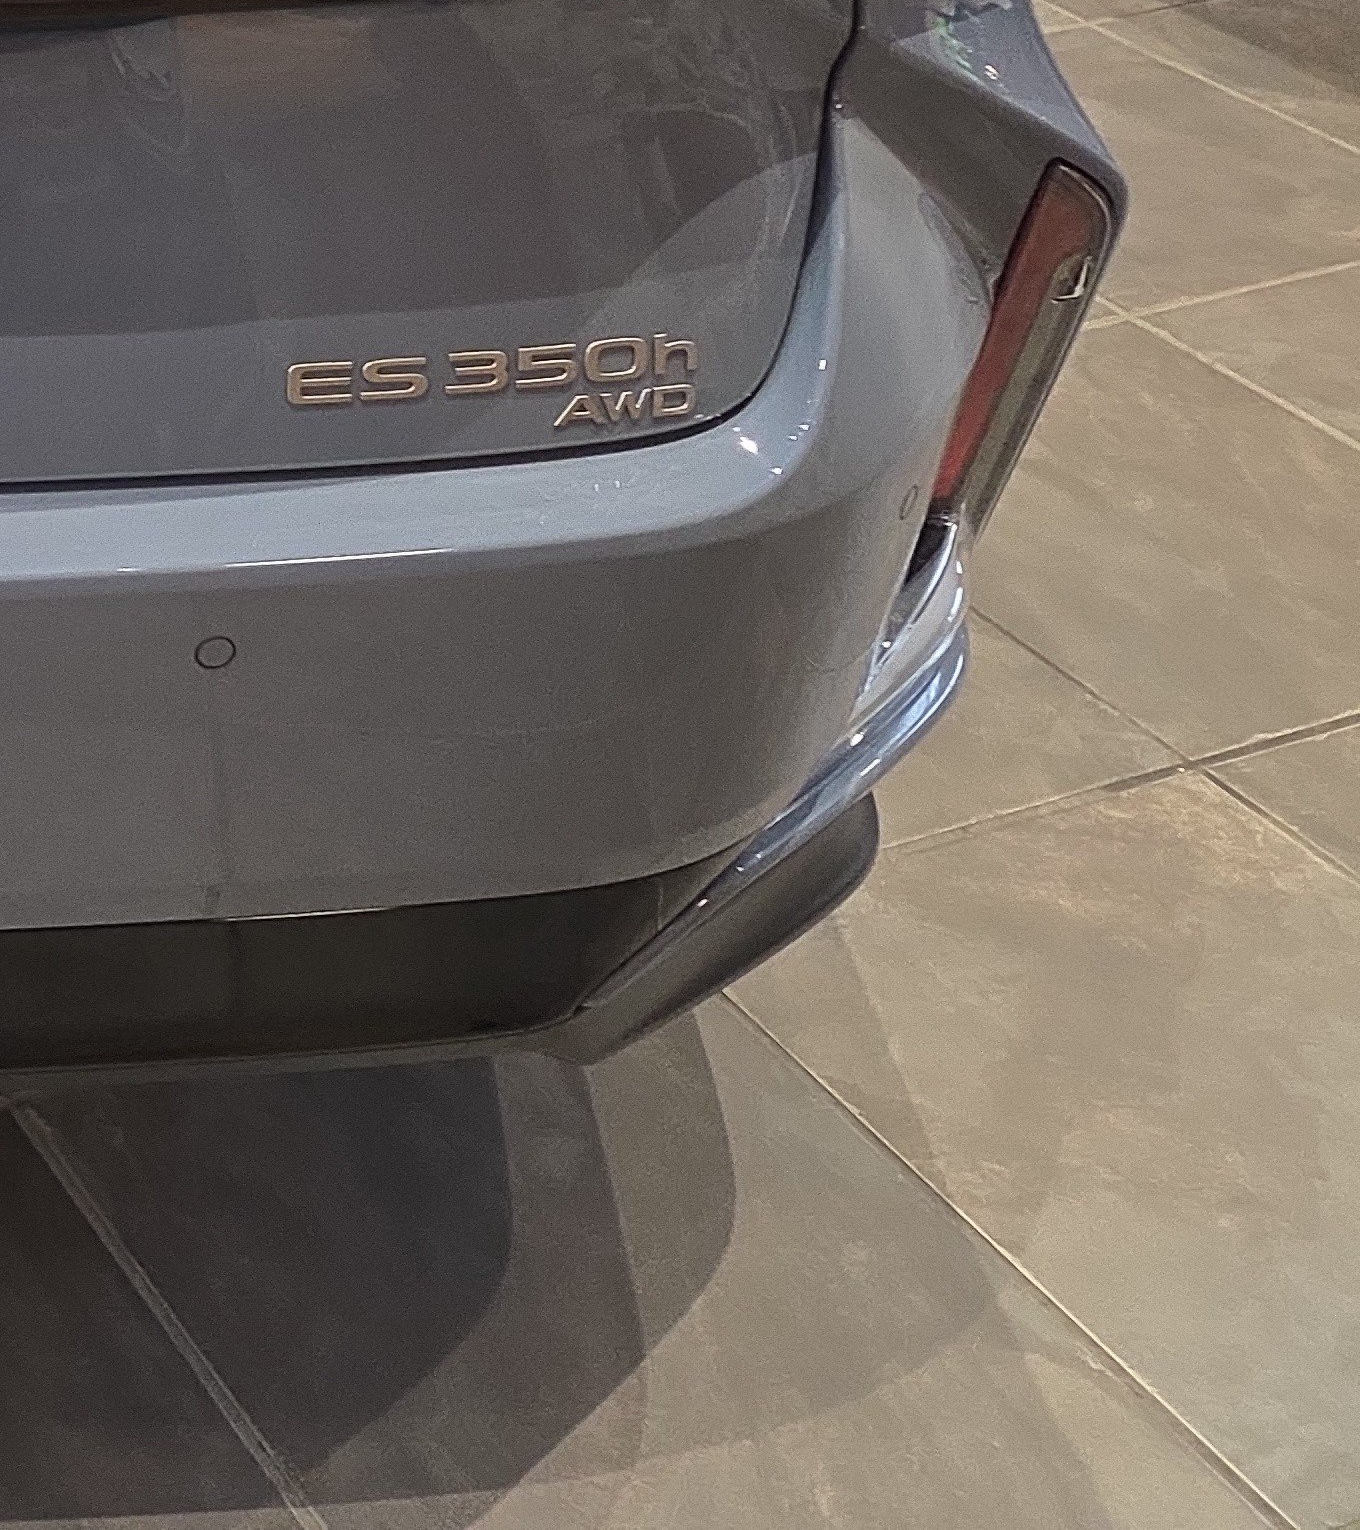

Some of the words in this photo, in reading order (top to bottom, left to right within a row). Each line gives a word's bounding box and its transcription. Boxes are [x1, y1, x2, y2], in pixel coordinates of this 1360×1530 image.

[287, 356, 429, 406] ES
[444, 333, 698, 396] 350h
[553, 383, 697, 428] AWD
